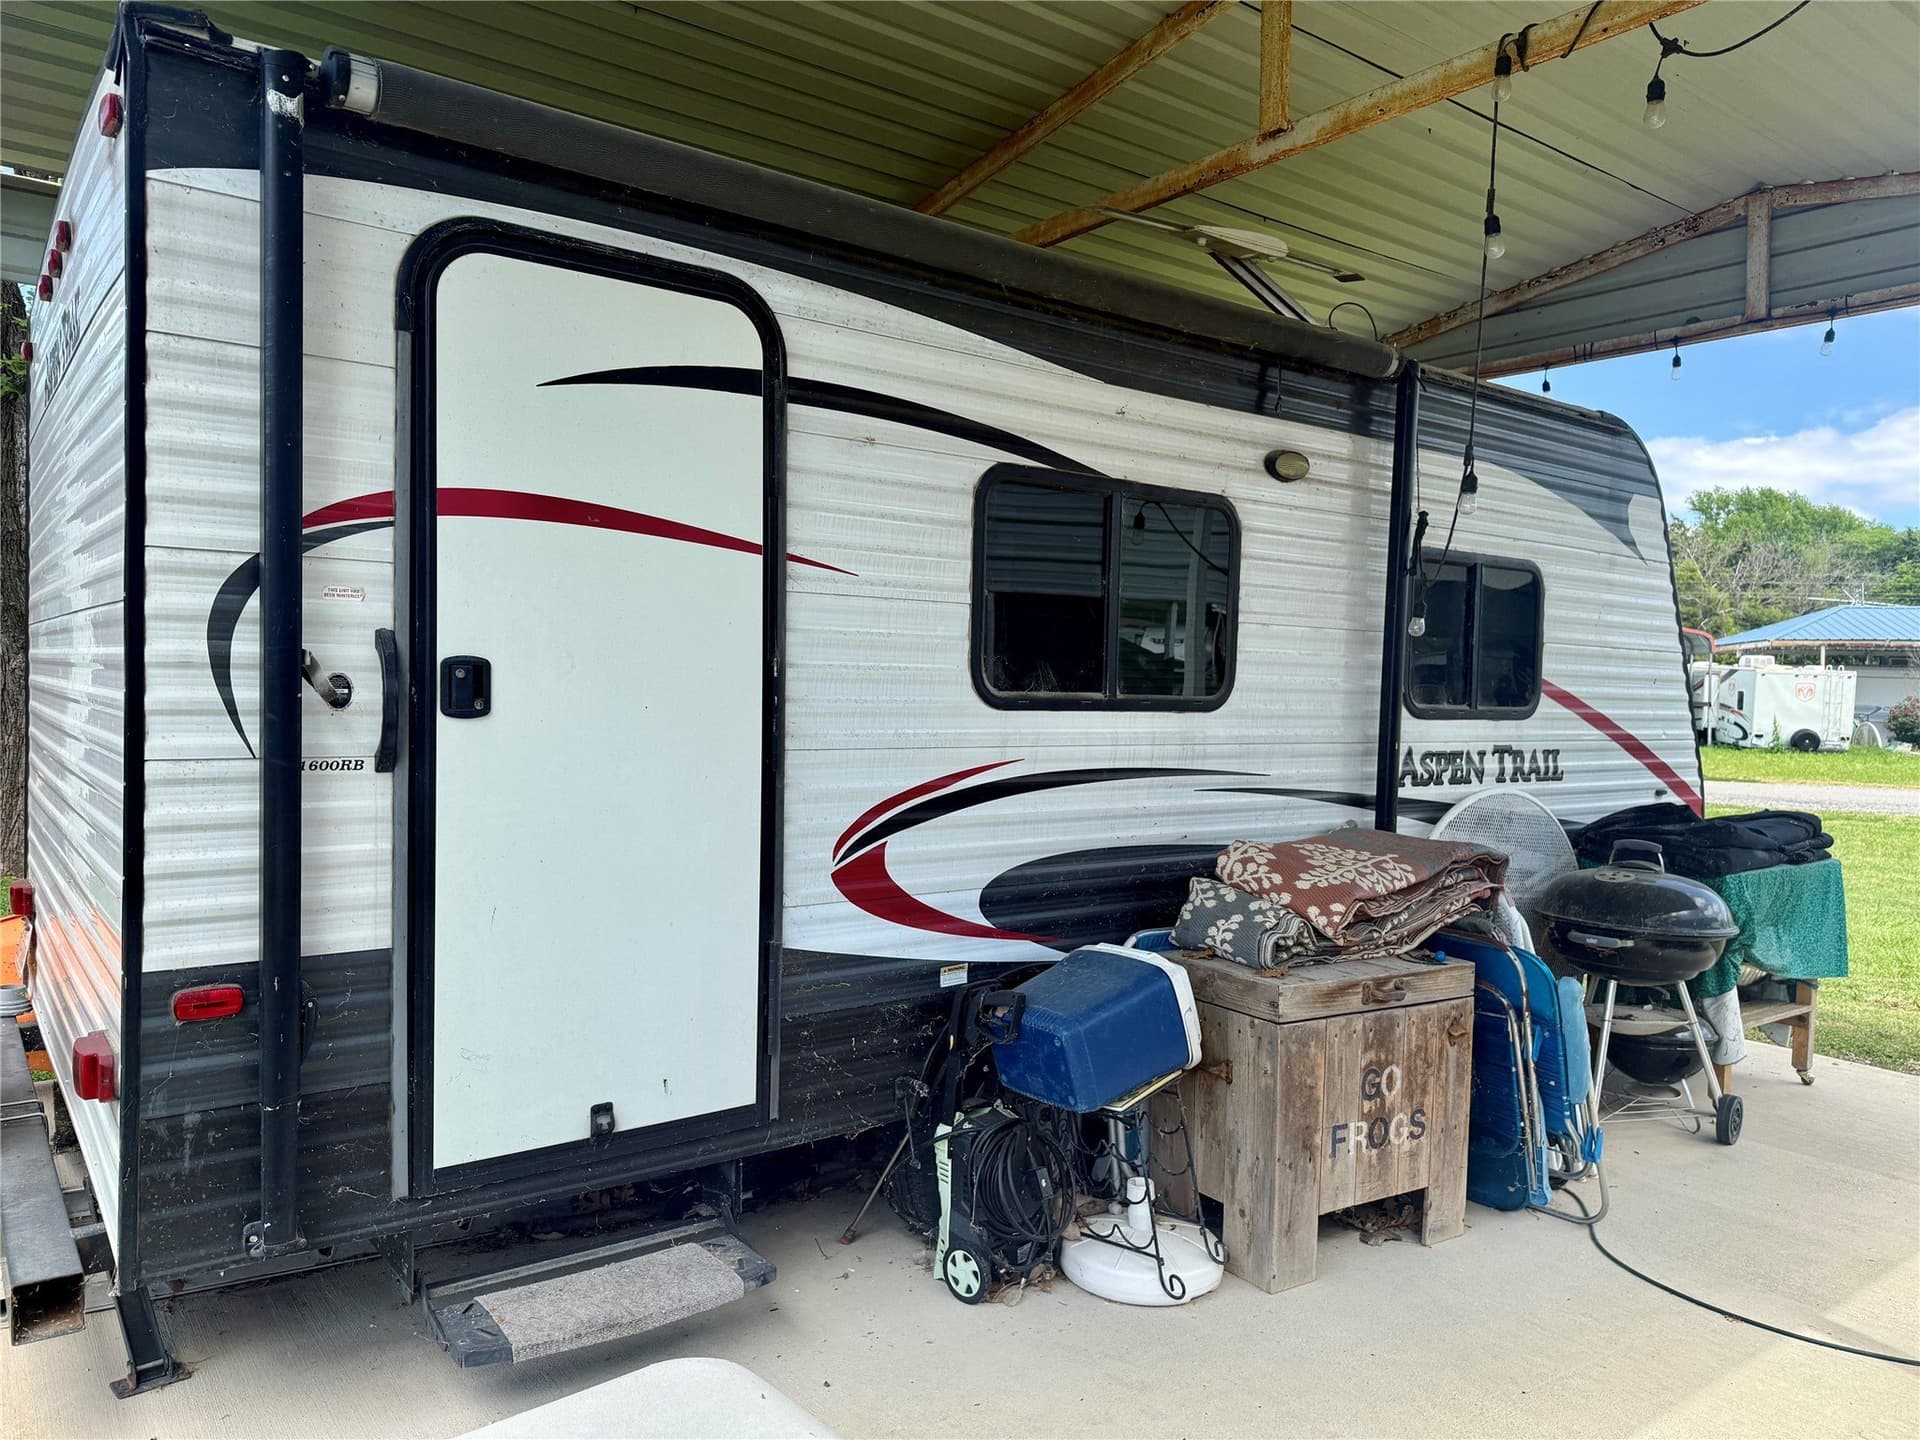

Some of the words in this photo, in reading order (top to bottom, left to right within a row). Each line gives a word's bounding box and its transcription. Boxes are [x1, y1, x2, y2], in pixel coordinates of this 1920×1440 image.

[301, 759, 365, 771] 1600RB
[1399, 745, 1486, 787] ASPEN
[1492, 744, 1564, 783] TRAIL
[1361, 1063, 1402, 1101] GO
[1331, 1108, 1426, 1159] FROGS
